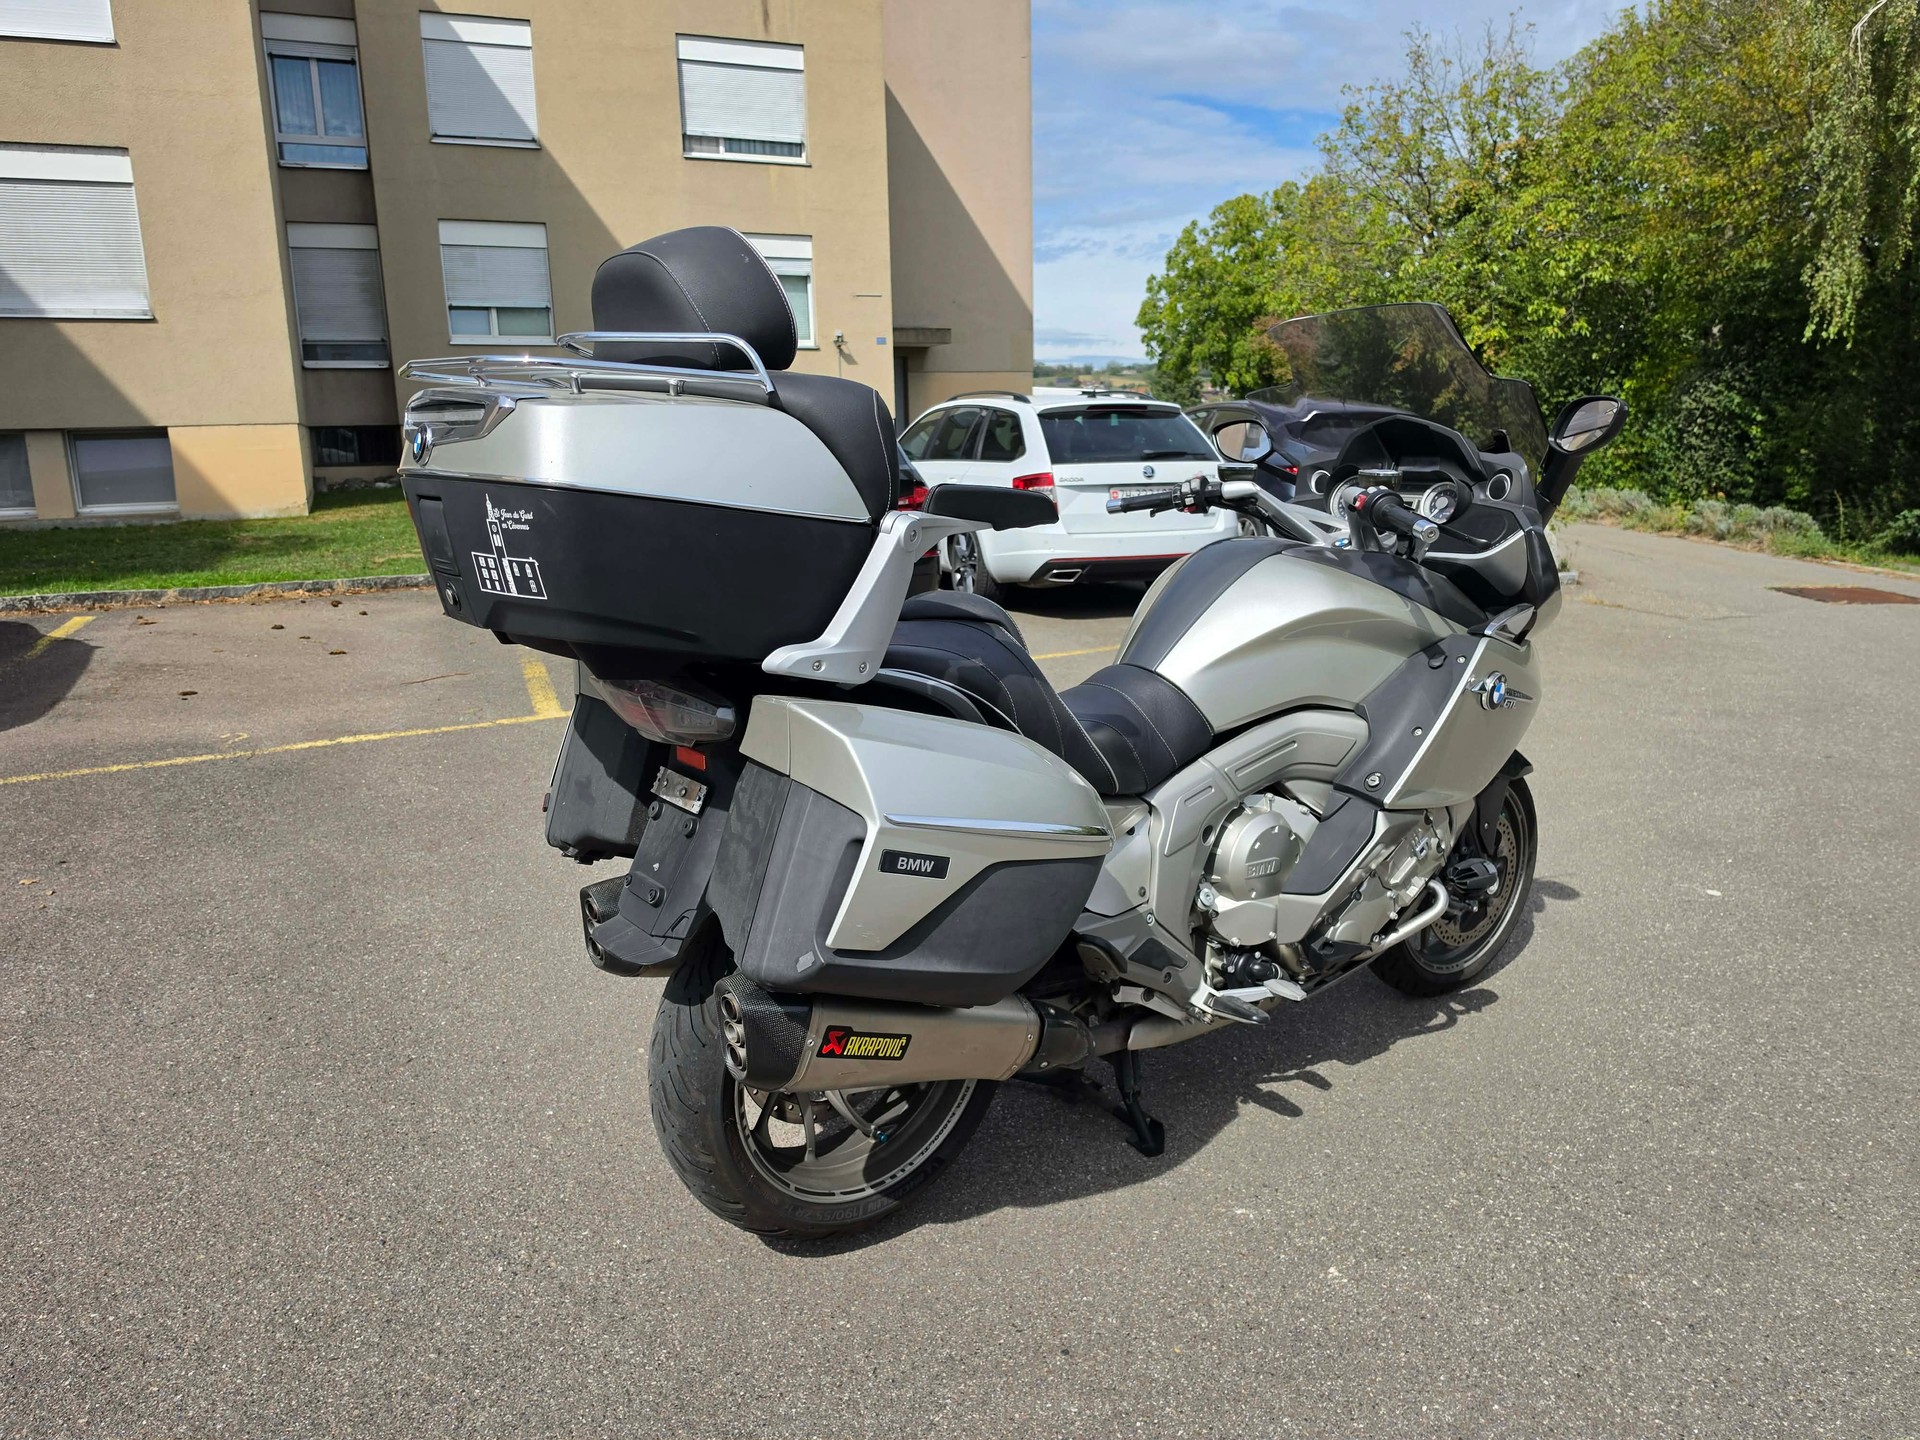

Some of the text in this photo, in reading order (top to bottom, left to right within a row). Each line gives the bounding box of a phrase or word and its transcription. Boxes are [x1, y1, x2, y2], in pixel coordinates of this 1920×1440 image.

[500, 508, 512, 521] Jean
[519, 509, 533, 521] Gard
[897, 857, 935, 873] BMW
[1248, 860, 1276, 876] BMW
